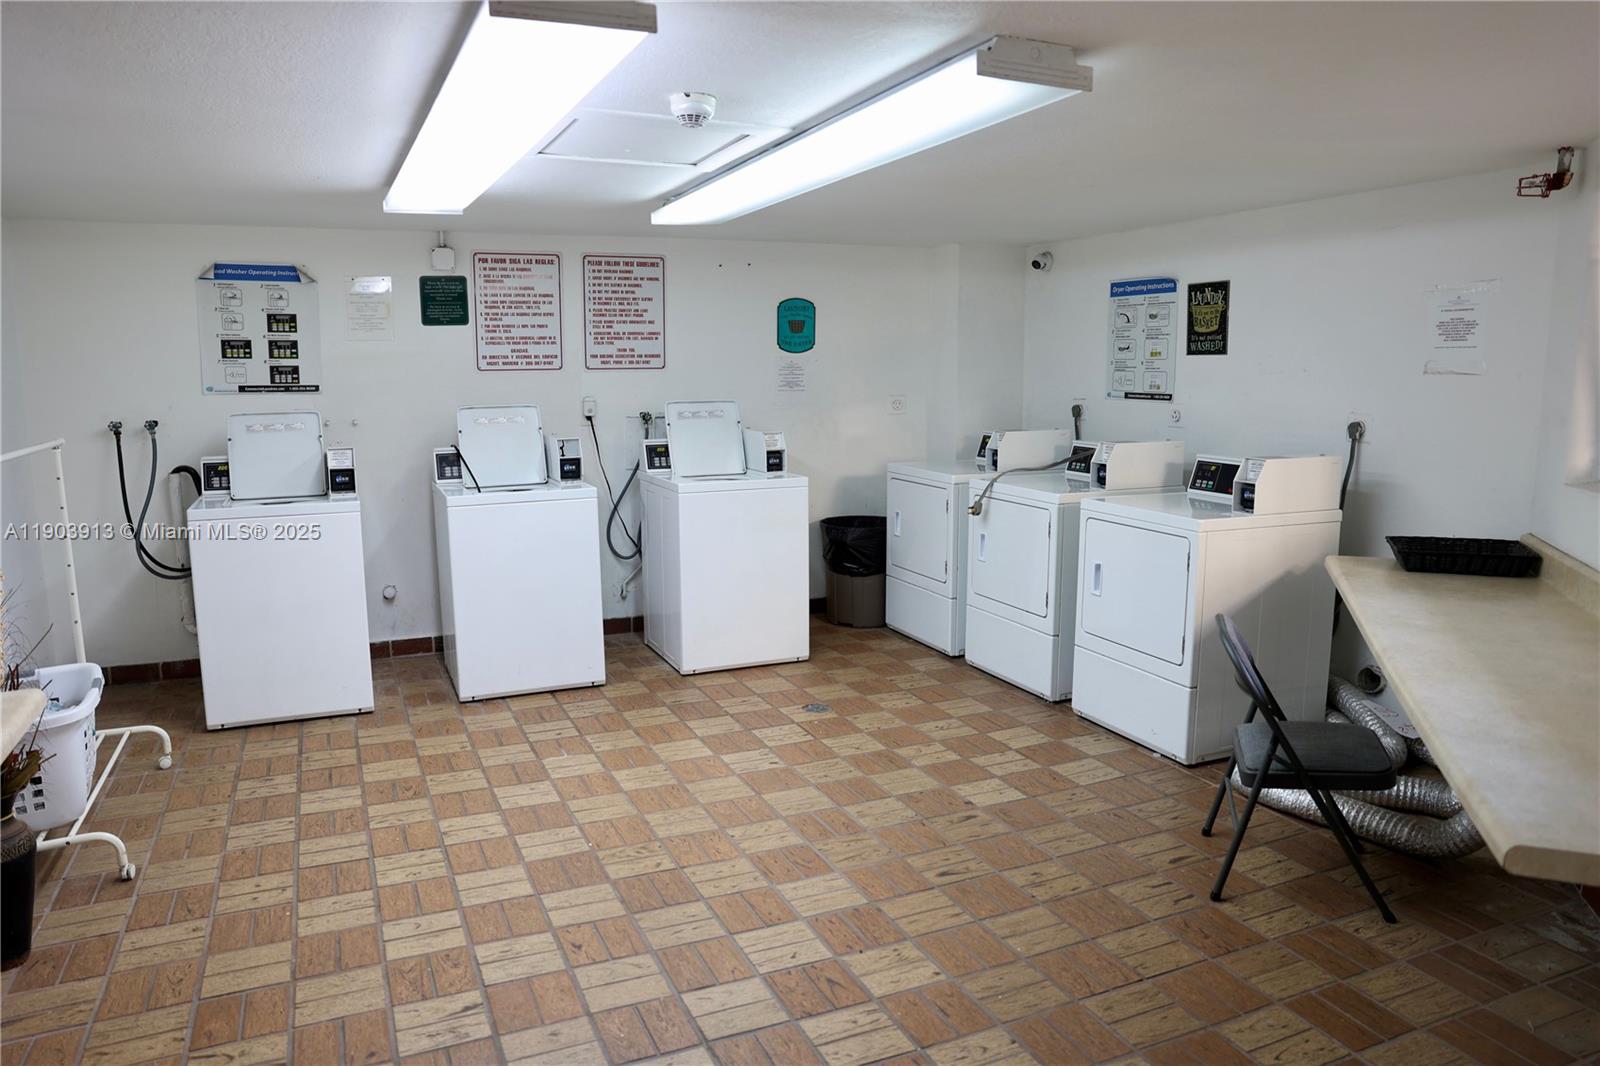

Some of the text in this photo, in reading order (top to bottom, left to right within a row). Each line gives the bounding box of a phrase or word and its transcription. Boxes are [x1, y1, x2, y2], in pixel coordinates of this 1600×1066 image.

[1112, 282, 1175, 294] Dryer Operating Instructions
[1191, 287, 1225, 305] LAUNDRY
[1193, 316, 1219, 329] BASKET
[1190, 340, 1223, 352] WASHED!
